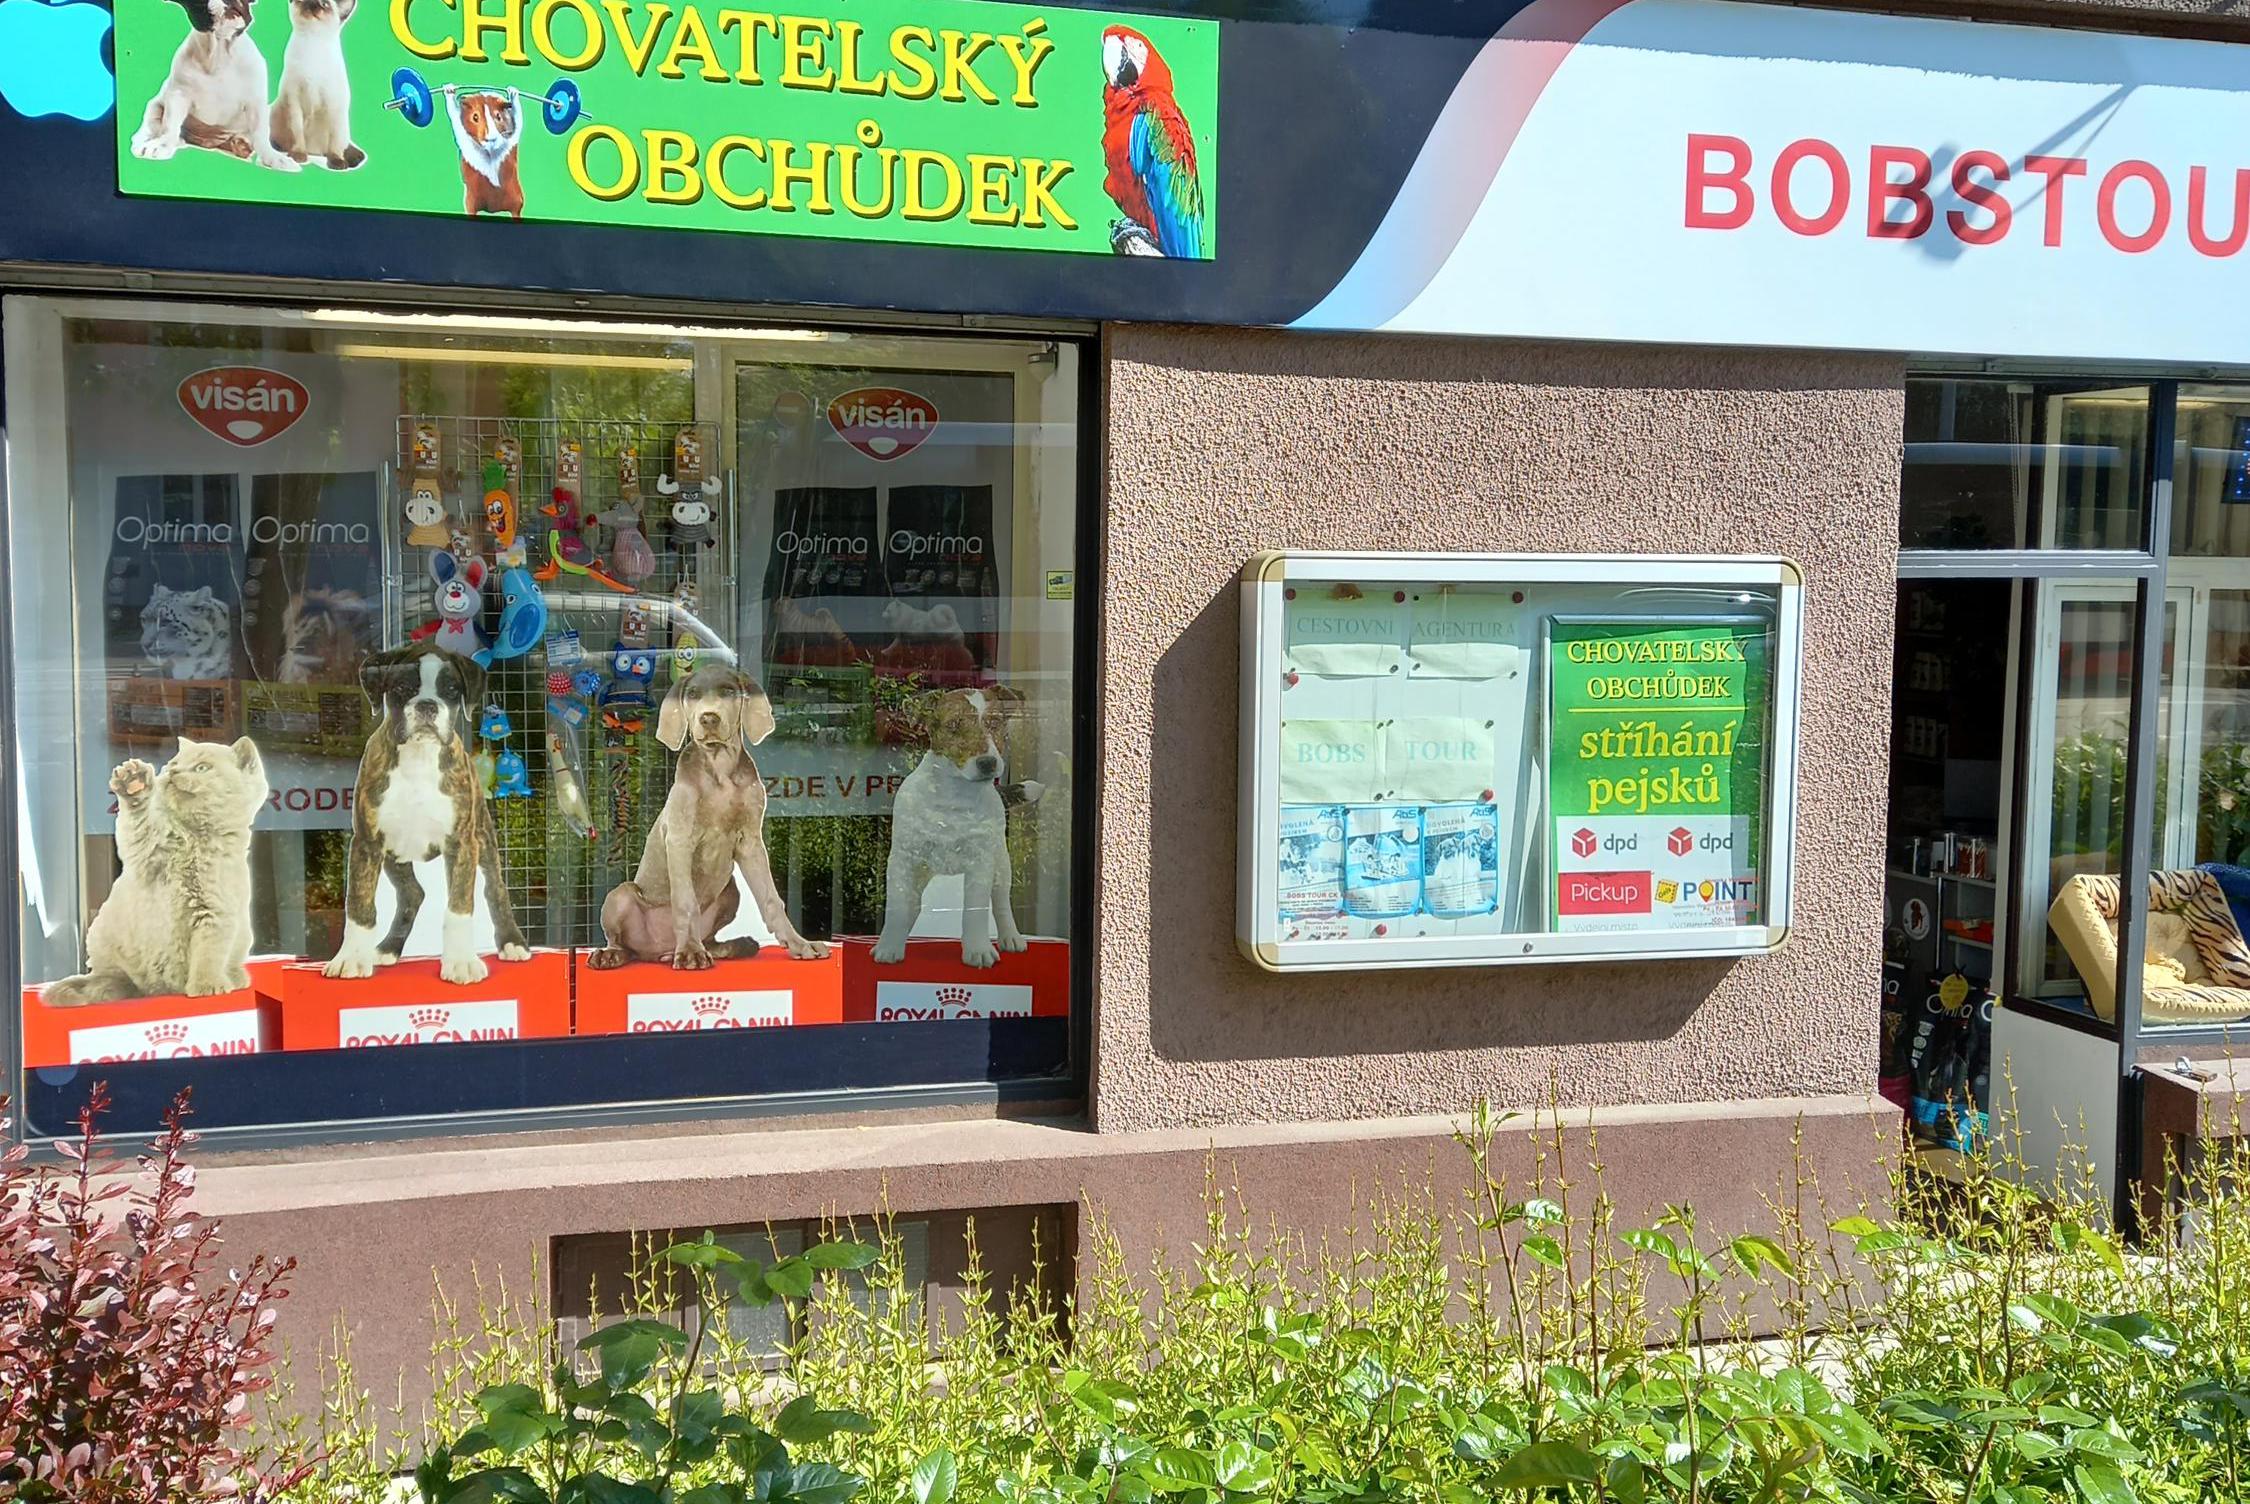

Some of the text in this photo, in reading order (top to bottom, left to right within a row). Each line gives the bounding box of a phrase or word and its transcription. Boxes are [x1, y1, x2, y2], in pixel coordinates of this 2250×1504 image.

[389, 0, 1055, 107] CHOVATELSKÝ
[566, 118, 1079, 230] OBCHŮDEK
[190, 377, 296, 413] visán
[837, 398, 927, 430] visán
[116, 515, 233, 550] Optima
[252, 515, 369, 551] Optima
[776, 530, 868, 561] Optima
[889, 530, 983, 561] Optima
[1411, 620, 1515, 638] AGENTURA
[1587, 669, 1732, 699] OBCHŮDEK
[1297, 740, 1478, 763] BOBS TOUR
[1579, 720, 1737, 758] stříhání
[764, 775, 826, 799] ZDE
[836, 775, 856, 798] V
[1587, 763, 1720, 814] pejsků
[1603, 833, 1637, 855] dpd
[1699, 832, 1733, 855] dpd
[1571, 882, 1638, 904] Pickup
